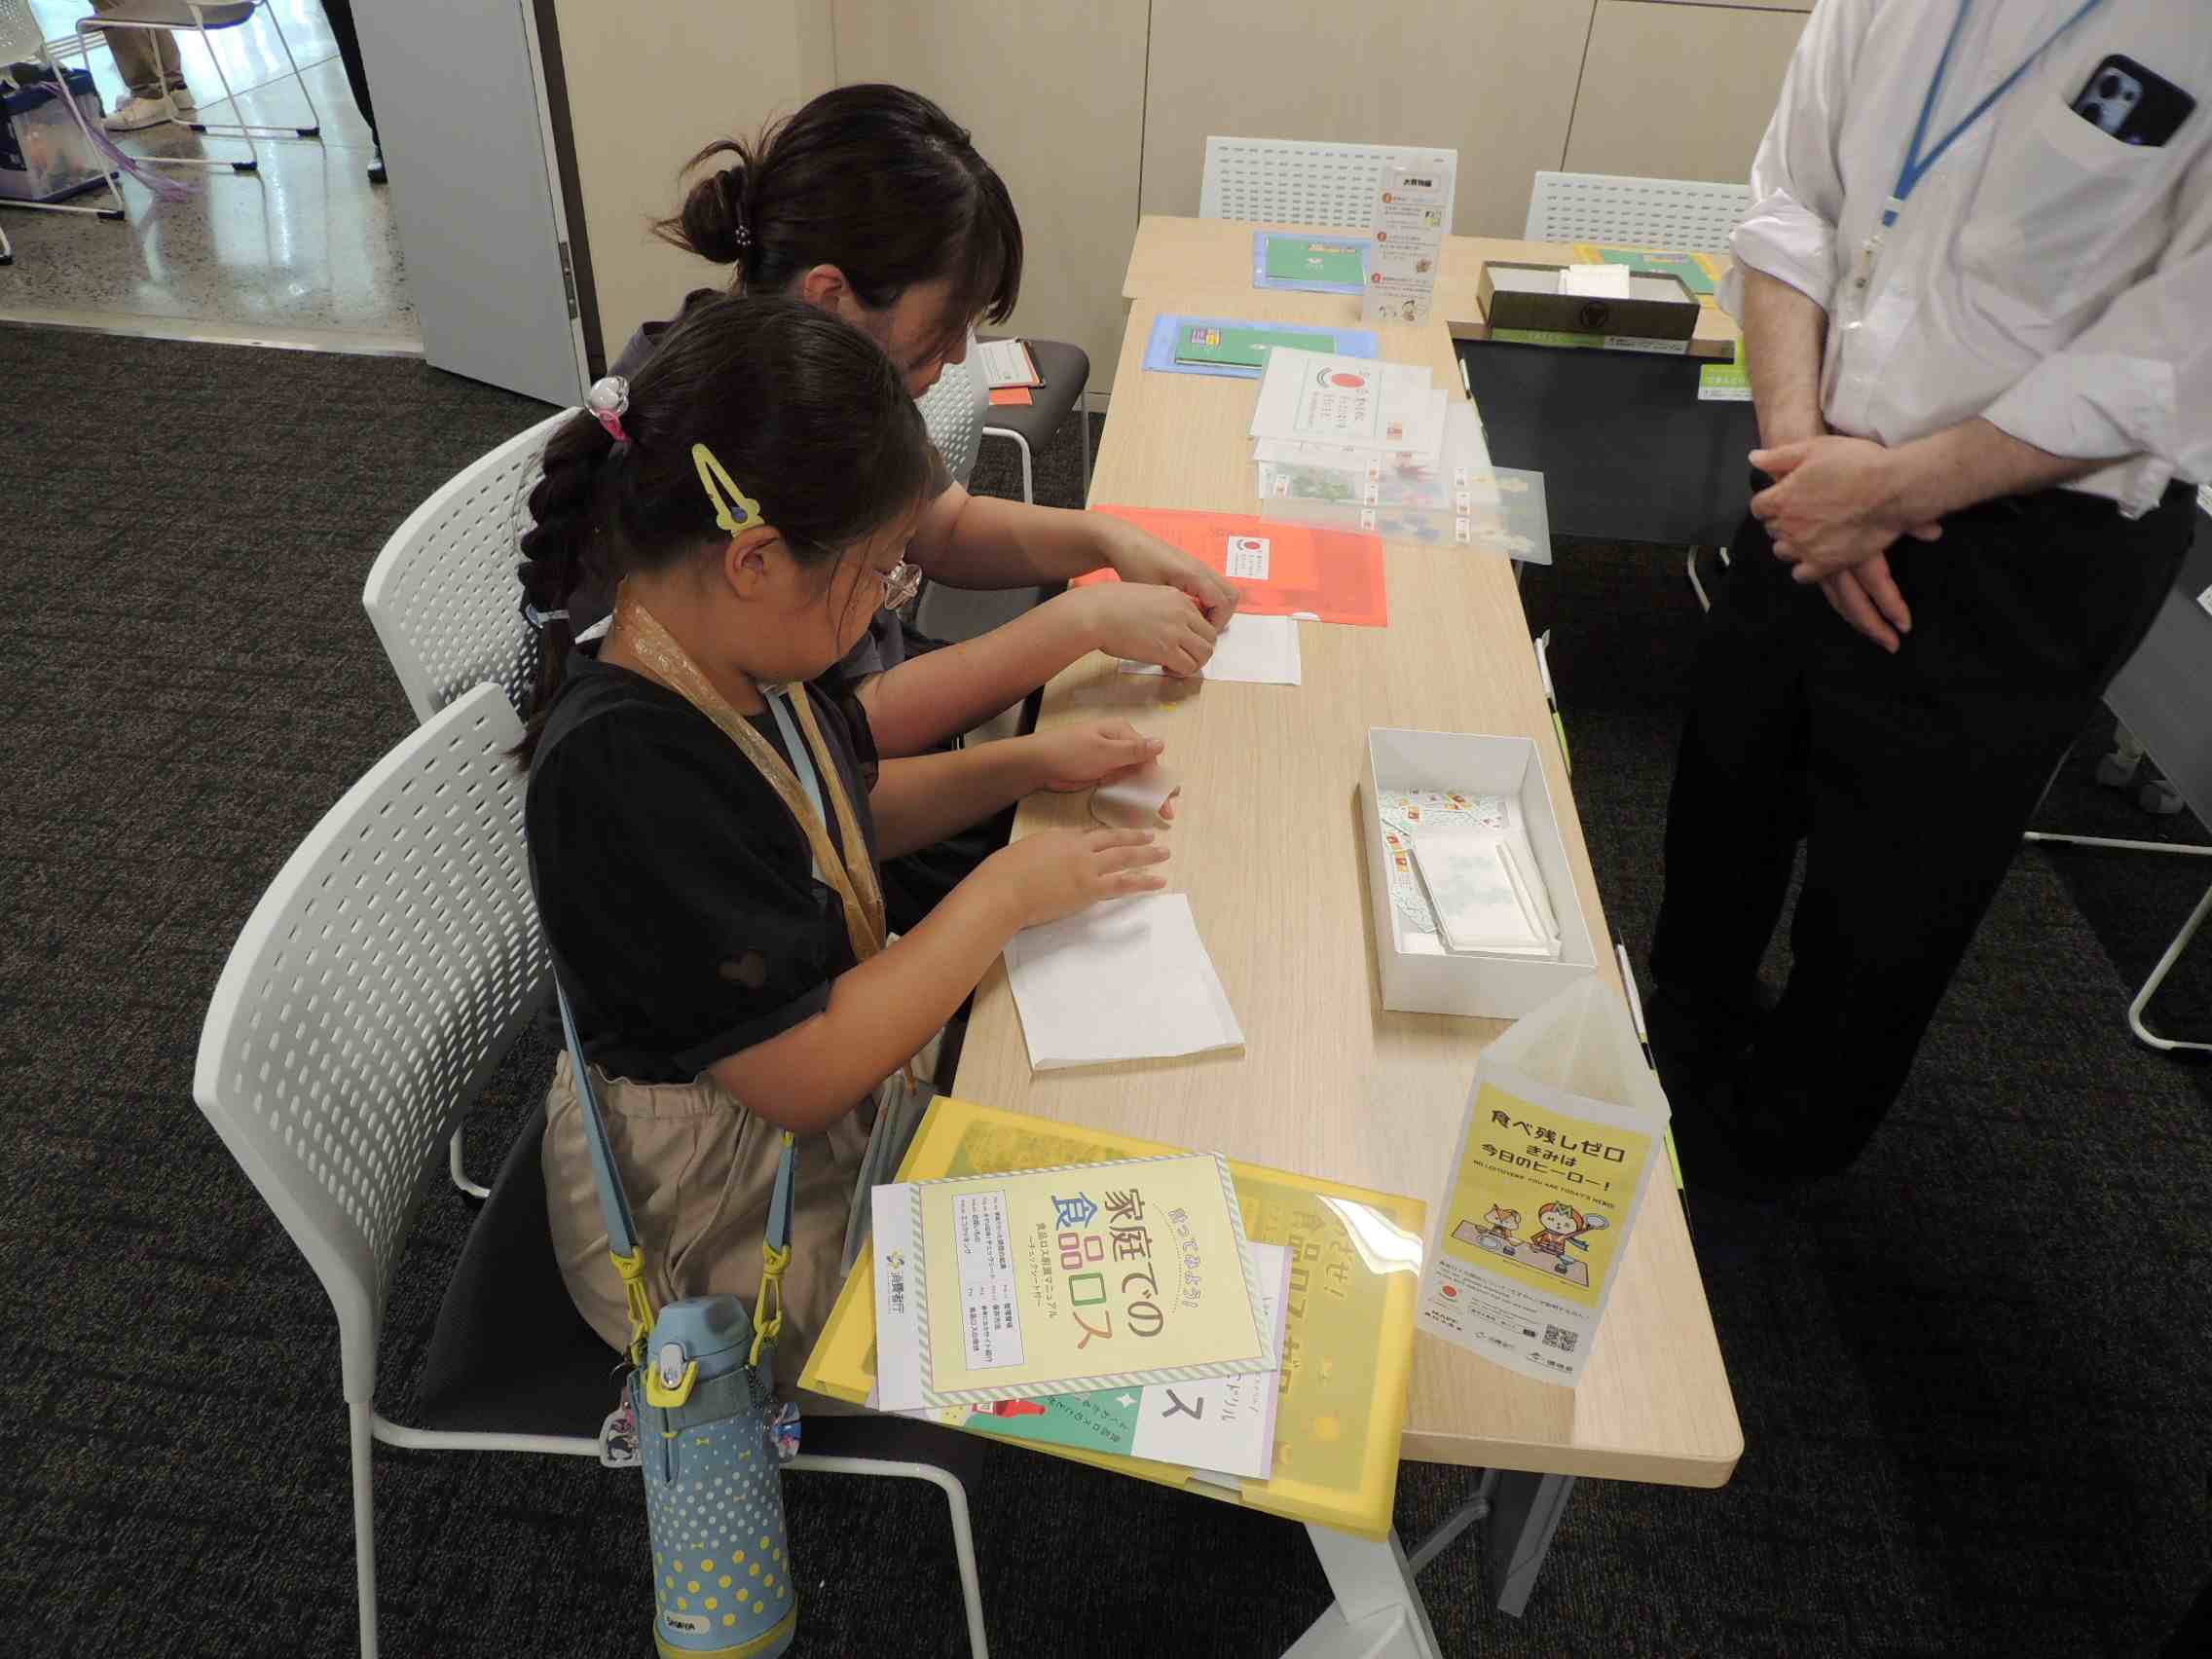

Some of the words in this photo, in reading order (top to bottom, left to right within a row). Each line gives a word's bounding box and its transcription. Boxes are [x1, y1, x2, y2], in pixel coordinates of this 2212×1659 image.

[1492, 1110, 1625, 1162] 食べ残しゼロ
[1526, 1145, 1578, 1167] きみは
[1482, 1144, 1610, 1191] 今日のヒーロー！
[1036, 1223, 1059, 1318] 食品ロス削減マニュアル
[1051, 1192, 1113, 1349] 食品ロス
[1104, 1189, 1163, 1337] 家庭での
[1161, 1388, 1204, 1420] ス
